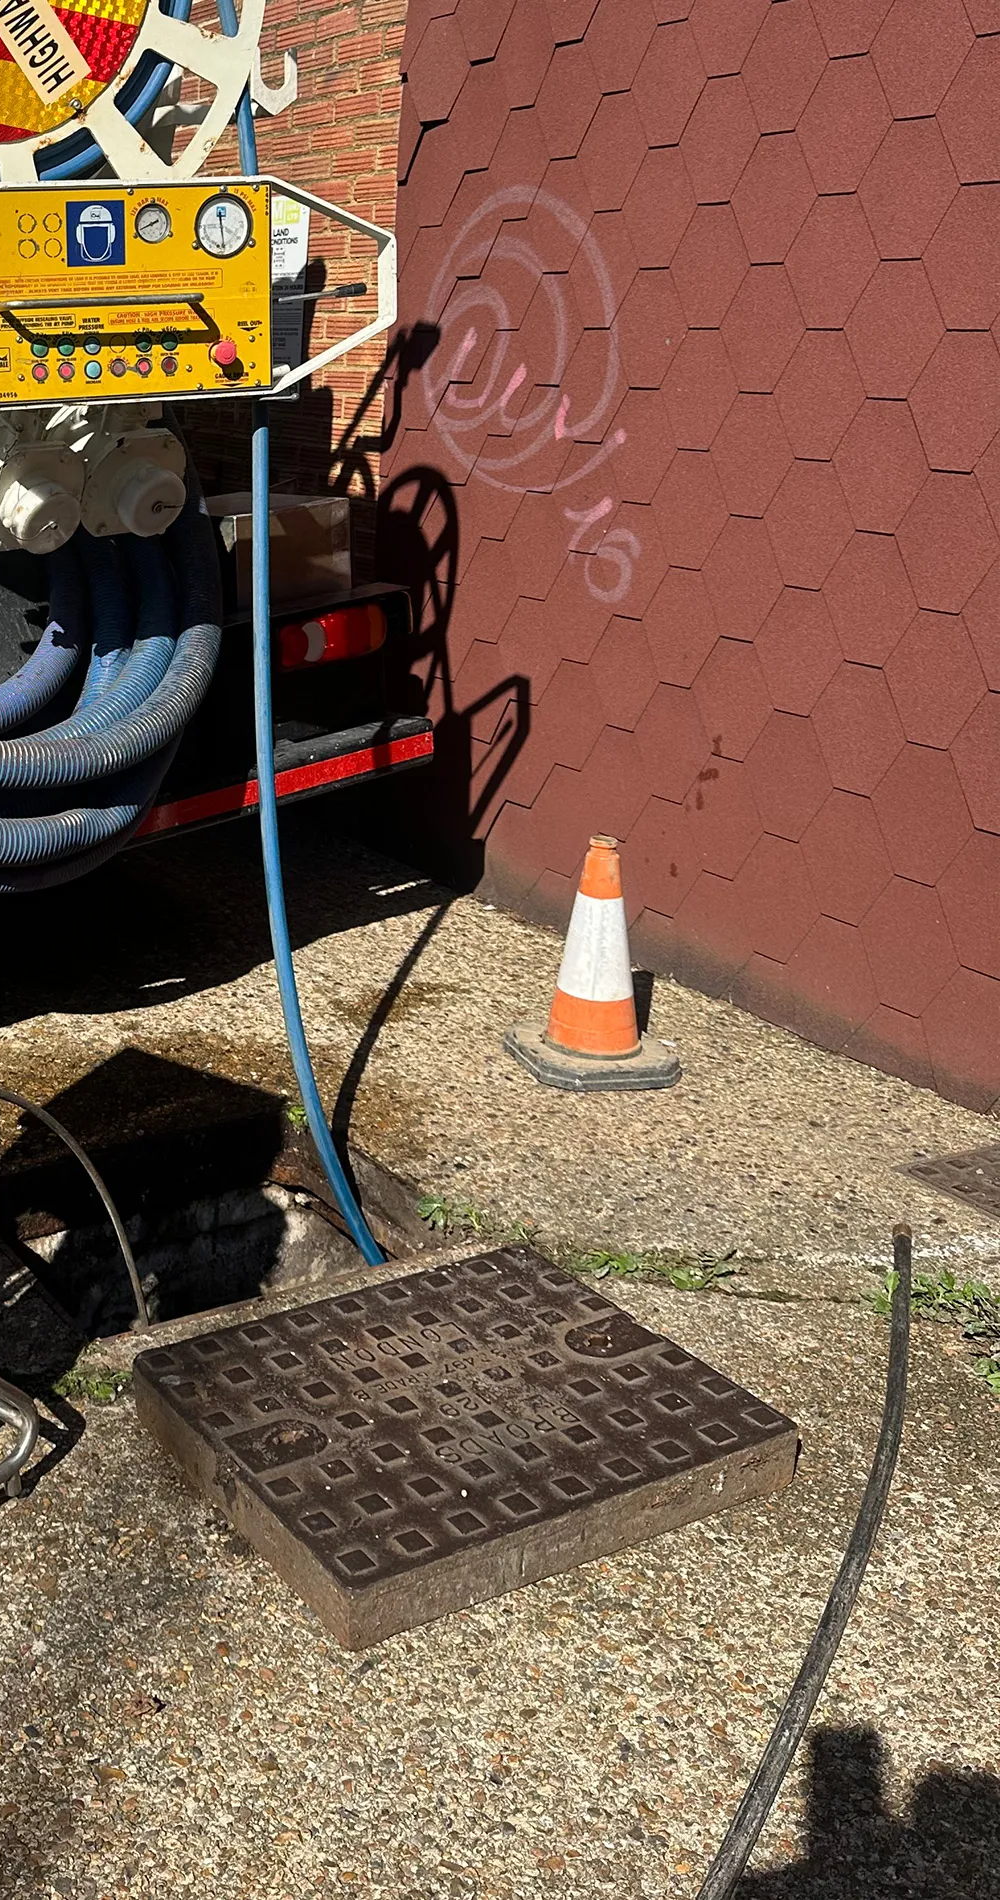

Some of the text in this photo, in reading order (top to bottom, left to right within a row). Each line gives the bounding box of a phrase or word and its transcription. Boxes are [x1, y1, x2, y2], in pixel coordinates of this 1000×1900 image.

[137, 197, 150, 206] BAR
[156, 197, 169, 206] MAX
[240, 191, 248, 200] PSI
[273, 228, 289, 237] LAND
[329, 1321, 468, 1371] LONDON
[378, 1371, 430, 1395] GRADE
[439, 1395, 492, 1418] 129
[434, 1404, 582, 1465] BROADS
